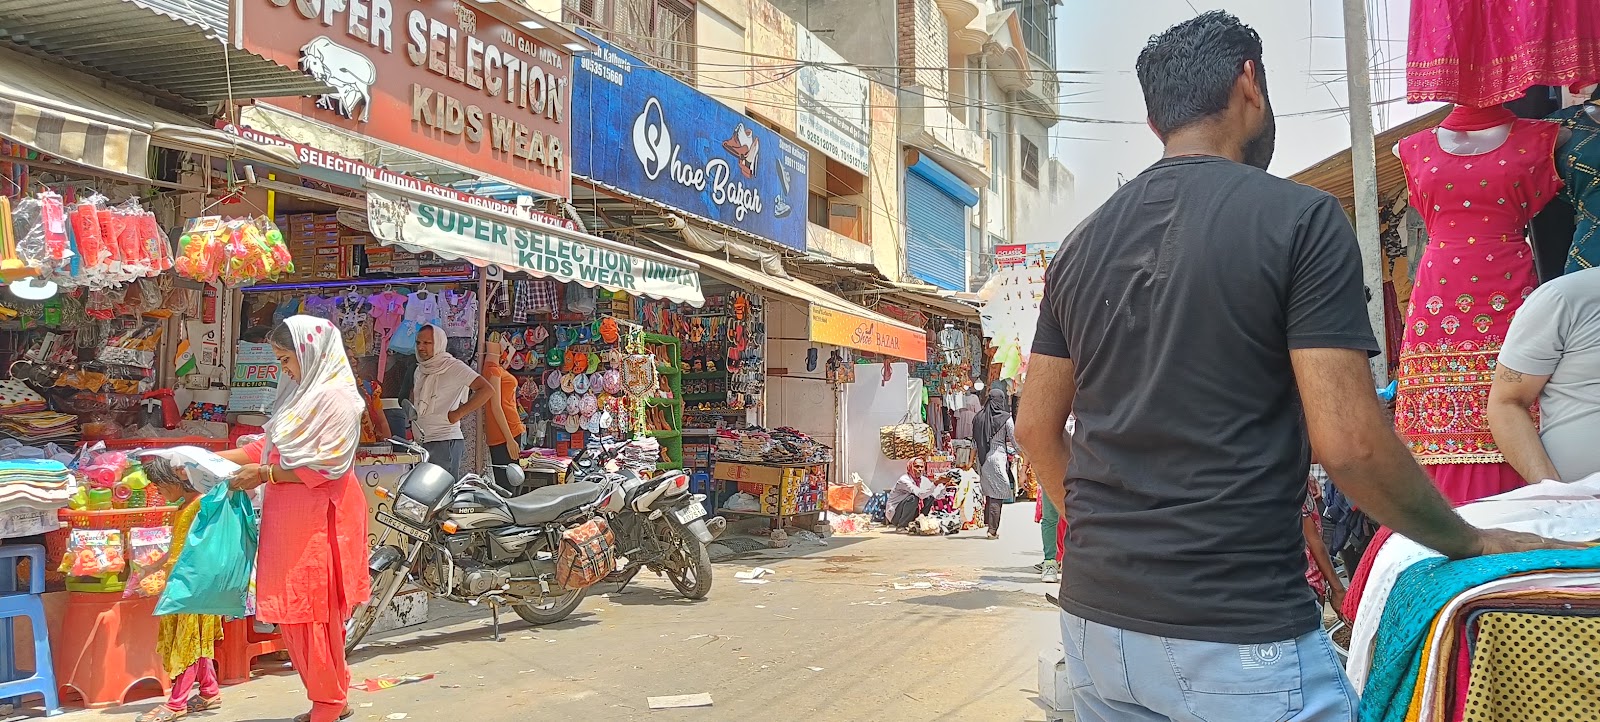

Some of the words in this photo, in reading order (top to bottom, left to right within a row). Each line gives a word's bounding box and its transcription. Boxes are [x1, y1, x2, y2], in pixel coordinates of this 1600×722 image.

[269, 0, 393, 54] PER
[500, 28, 516, 48] JAI
[517, 36, 537, 58] GAU
[539, 46, 563, 70] MATA
[242, 130, 293, 150] SUP
[411, 82, 484, 143] KIDS
[489, 112, 564, 172] WEAR
[417, 202, 508, 246] SUPER
[642, 258, 701, 293] (INDIA)
[518, 250, 574, 277] KIDS
[579, 265, 636, 290] WEAR
[876, 332, 900, 350] BAZAR
[233, 364, 279, 380] UPER
